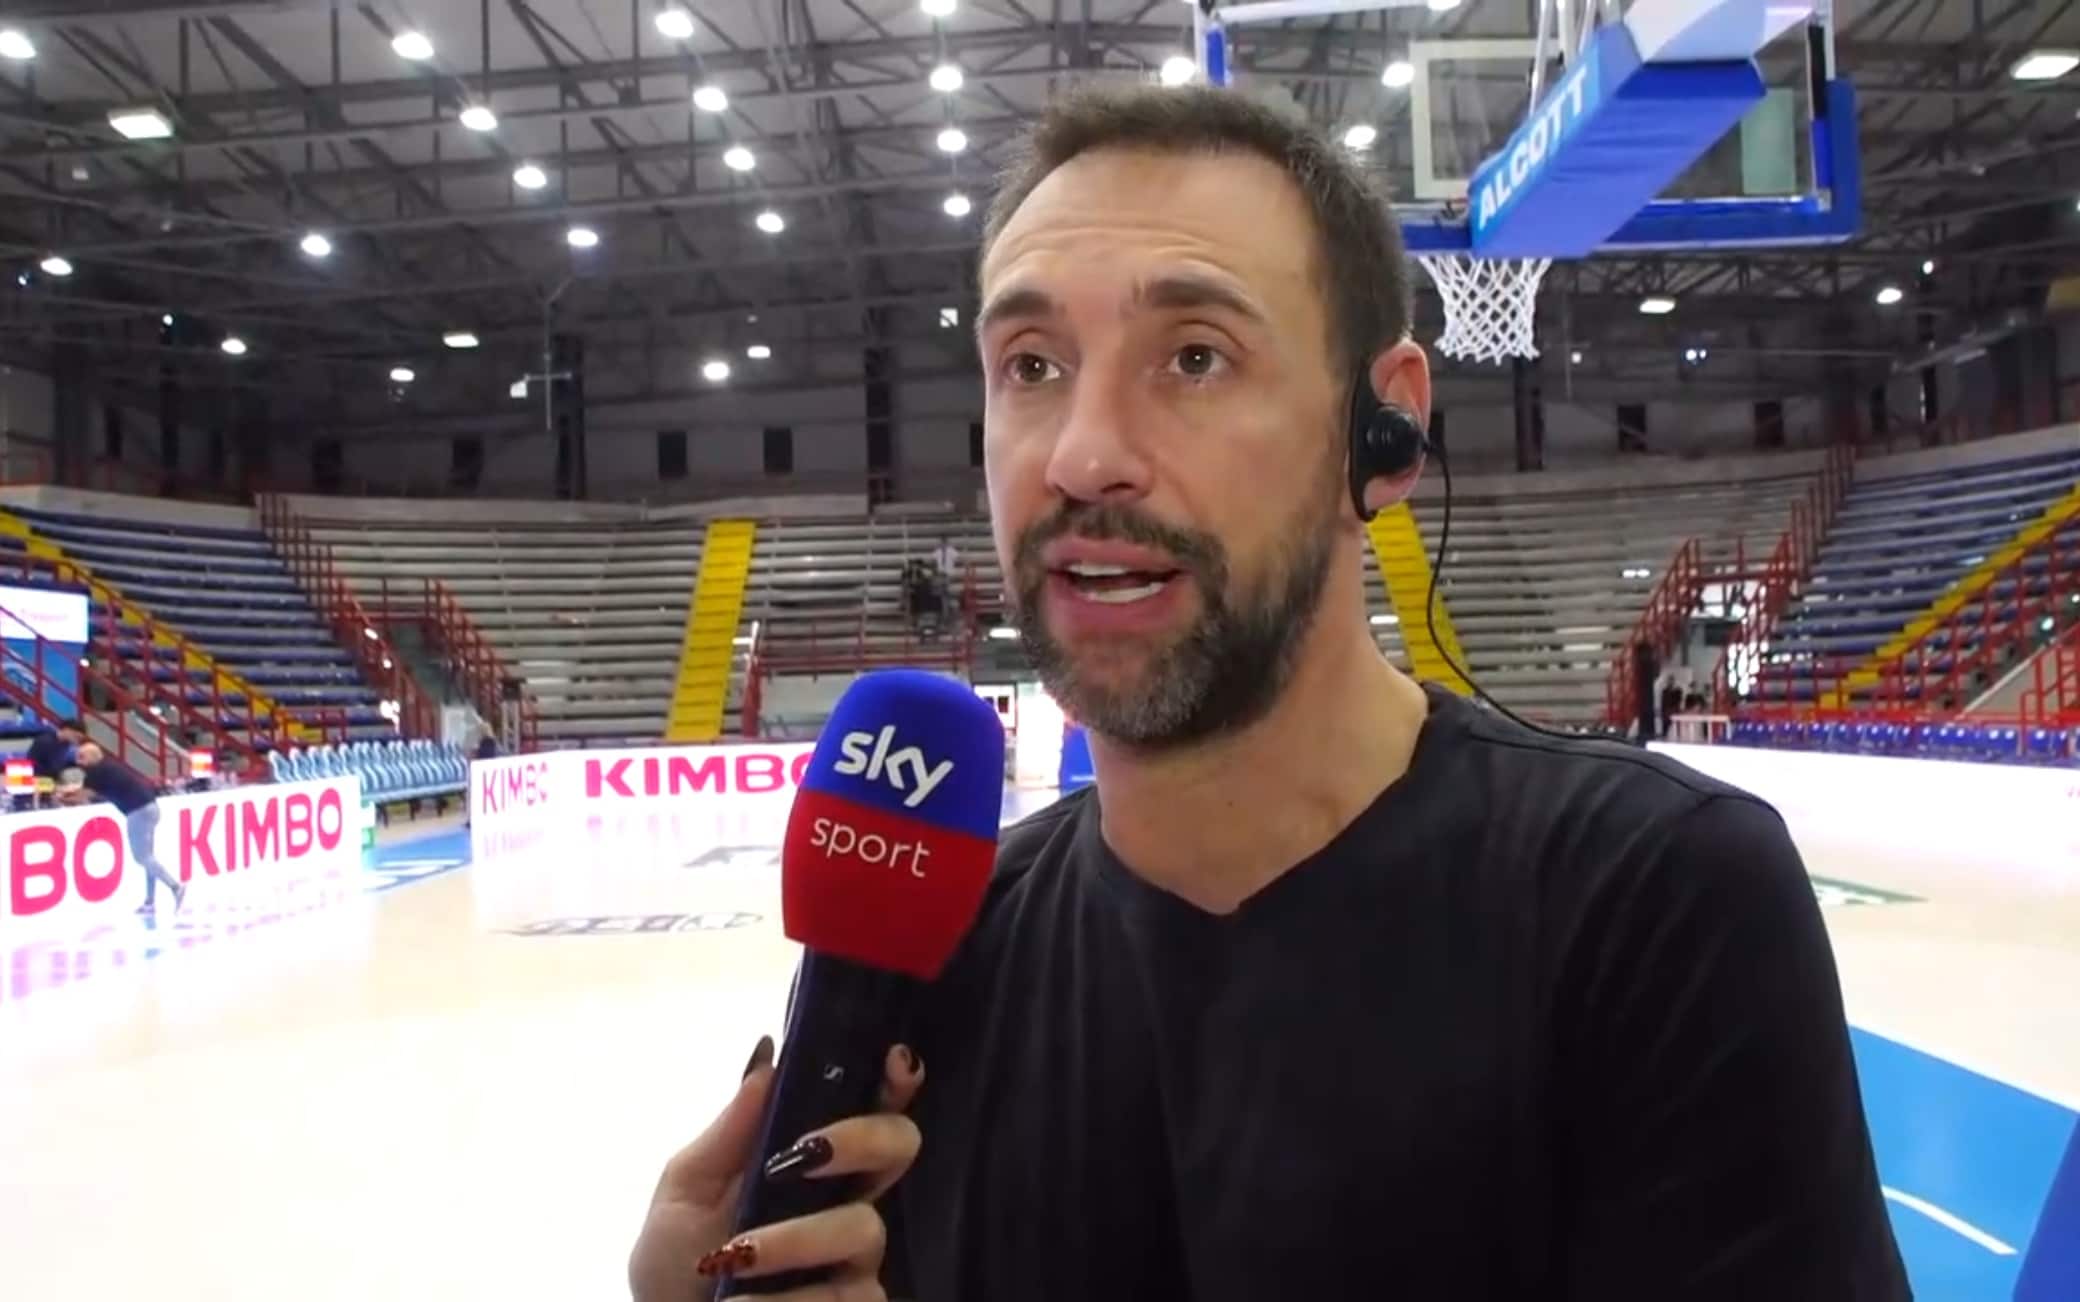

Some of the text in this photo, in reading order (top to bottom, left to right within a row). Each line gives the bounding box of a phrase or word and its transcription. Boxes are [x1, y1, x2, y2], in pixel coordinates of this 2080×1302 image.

[1479, 66, 1587, 230] ALCOTT
[833, 725, 954, 807] sky
[179, 788, 343, 882] KIMBO
[810, 818, 931, 877] sport
